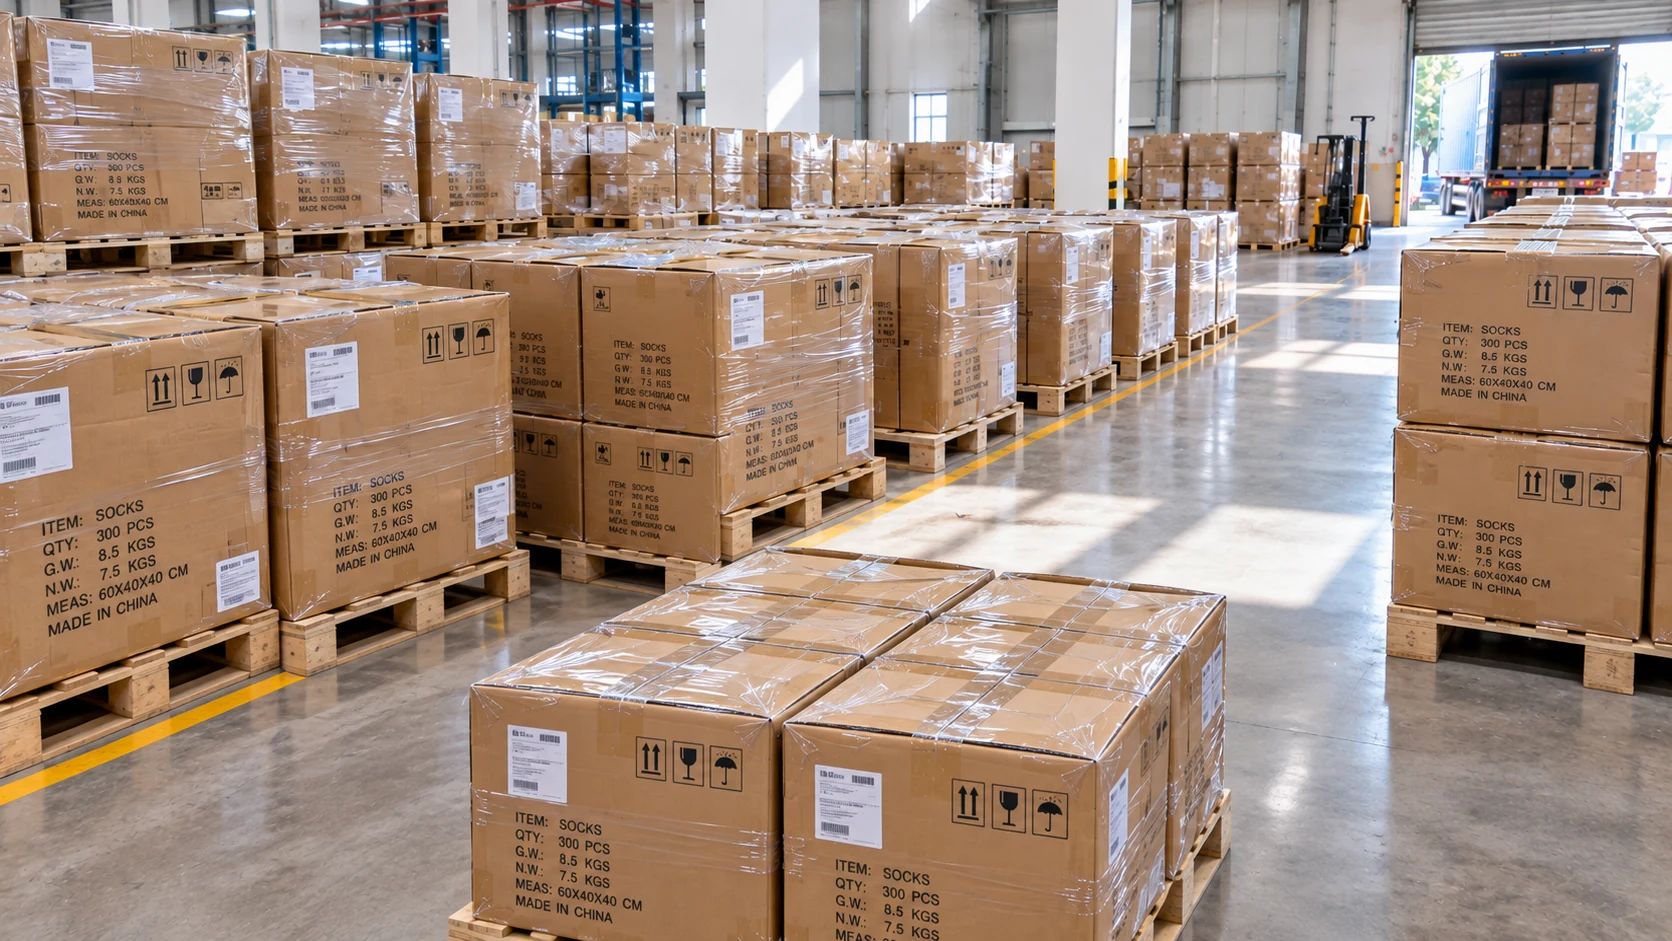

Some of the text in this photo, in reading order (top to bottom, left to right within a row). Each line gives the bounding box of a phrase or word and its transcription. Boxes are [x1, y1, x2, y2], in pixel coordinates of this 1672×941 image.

[78, 211, 104, 219] MADE
[1443, 323, 1520, 336] ITEM: SOCKS
[614, 340, 666, 352] ITEM: SOCKS
[1443, 336, 1528, 349] QTY: 300 PCS
[615, 352, 632, 360] QTY:
[656, 356, 671, 365] PCS
[1482, 352, 1497, 360] 8.5
[1504, 353, 1527, 363] KGS
[1482, 365, 1497, 374] 7.5
[1503, 366, 1526, 376] KGS
[1441, 375, 1475, 385] MEAS:
[1538, 381, 1556, 391] CM
[615, 399, 636, 409] MADE
[648, 402, 672, 411] CHINA
[677, 393, 690, 402] CM
[1441, 388, 1527, 402] MADE IN CHINA
[802, 440, 814, 450] CM
[334, 471, 404, 498] ITEM: SOCKS
[746, 469, 766, 482] MADE
[770, 464, 776, 473] IN
[334, 485, 412, 513] QTY: 300 PCS
[372, 509, 386, 518] 8.5
[392, 500, 413, 513] KGS
[42, 500, 143, 536] ITEM: SOCKS
[373, 523, 387, 533] 7.5
[393, 514, 413, 528] KGS
[1438, 514, 1514, 531] ITEM: SOCKS
[43, 517, 154, 556] QTY: 300 PCS
[336, 521, 437, 558] MEAS: 60X40X40 CM
[1438, 528, 1522, 546] QTY: 300 PCS
[44, 536, 155, 576] G.W.: 8.5 KGS
[337, 543, 415, 574] MADE IN CHINA
[1476, 545, 1492, 555] 8.5
[1499, 548, 1521, 559] KGS
[46, 555, 156, 597] N.W.: 7.5 KGS
[1437, 564, 1550, 588] MEAS: 60X40X40 CM
[1476, 558, 1491, 567] 7.5
[1499, 561, 1521, 571] KGS
[47, 564, 188, 617] MEAS: 60X40X40 CM
[1436, 576, 1521, 596] MADE IN CHINA
[48, 592, 158, 637] MADE IN CHINA
[516, 812, 602, 835] ITEM: SOCKS
[516, 829, 610, 855] QTY: 300 PCS
[516, 846, 610, 872] G.W.: 8.5 KGS
[516, 862, 610, 888] N.W.: 7.5 KGS
[836, 859, 930, 886] ITEM: SOCKS
[516, 878, 642, 911] MEAS: 60X40X40 CM
[836, 878, 939, 906] QTY: 300 PCS
[516, 895, 612, 923] MADE IN CHINA
[836, 895, 939, 924] G.W.: 8.5 KGS
[836, 912, 939, 941] N.W.: 7.5 KGS
